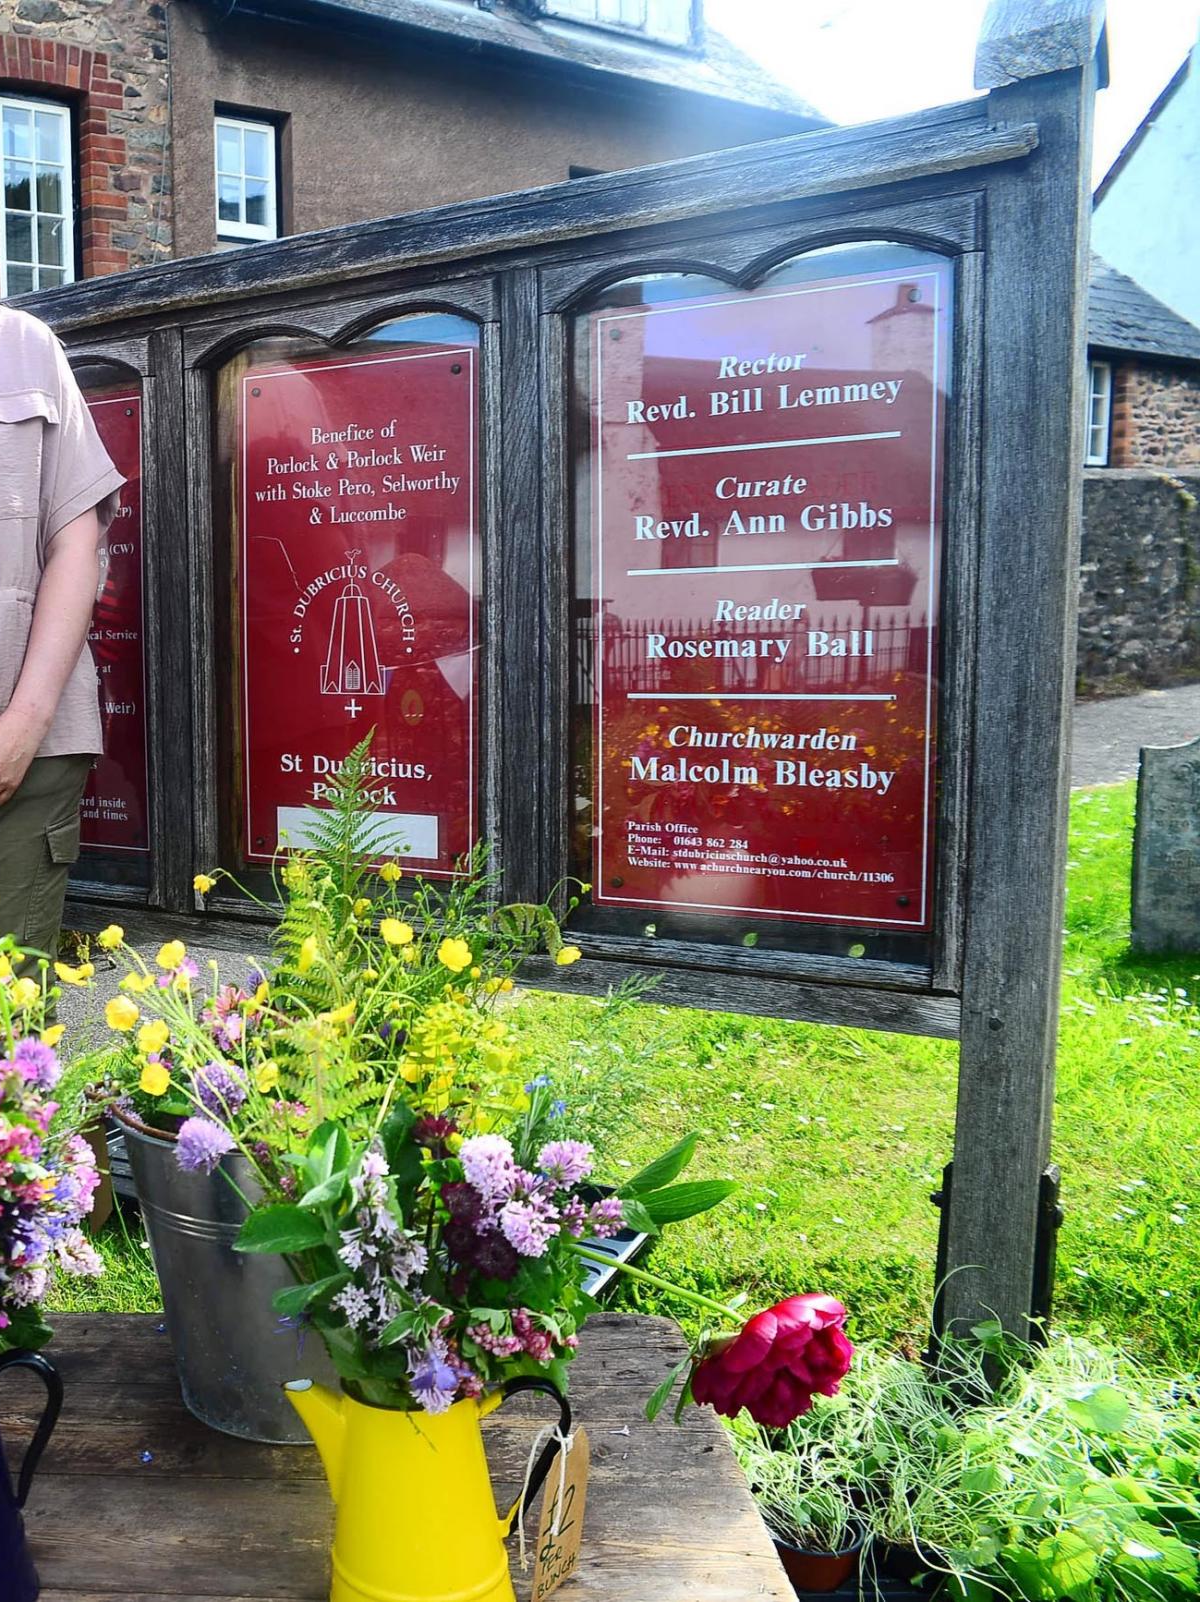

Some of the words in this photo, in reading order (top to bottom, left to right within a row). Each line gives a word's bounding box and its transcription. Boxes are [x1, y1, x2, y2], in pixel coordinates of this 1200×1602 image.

[718, 351, 806, 379] Rector
[626, 398, 696, 425] Revd.
[709, 387, 762, 417] Bill
[777, 378, 903, 410] Lemmey
[311, 424, 374, 445] Benefice
[381, 419, 397, 438] of
[267, 455, 319, 475] Porlock
[326, 452, 339, 470] &
[347, 448, 403, 469] Porlock
[409, 444, 447, 463] Weir
[255, 484, 286, 502] with
[292, 480, 332, 500] Stoke
[338, 478, 375, 497] Pero,
[382, 471, 460, 495] Selworthy
[715, 474, 807, 499] Curate
[309, 507, 322, 525] &
[330, 503, 406, 524] Luccombe
[634, 513, 709, 541] Revd.
[723, 509, 786, 536] Ann
[800, 502, 893, 531] Gibbs
[109, 543, 134, 556] (CW)
[293, 565, 367, 618] DUBRICIUS
[372, 572, 415, 641] CHURCH
[714, 598, 806, 622] Reader
[106, 629, 138, 640] Service
[646, 633, 792, 662] Rosemary
[806, 630, 875, 657] Ball
[105, 701, 136, 715] Weir)
[668, 725, 858, 751] Churchwarden
[280, 754, 303, 772] St
[628, 755, 759, 785] Malcolm
[775, 760, 896, 795] Bleasby
[83, 808, 99, 819] and
[103, 809, 128, 821] times
[99, 796, 127, 809] inside
[628, 821, 661, 832] Parish
[666, 822, 699, 834] Office
[628, 833, 662, 844] Phone:
[673, 835, 703, 847] 01643
[706, 838, 725, 849] 862
[729, 839, 748, 850] 284
[628, 845, 669, 857] E-Mail:
[672, 848, 848, 868] stdubriciuschurch@yahoo.co.uk
[628, 856, 671, 868] Website:
[537, 1552, 577, 1600] BUNCH
